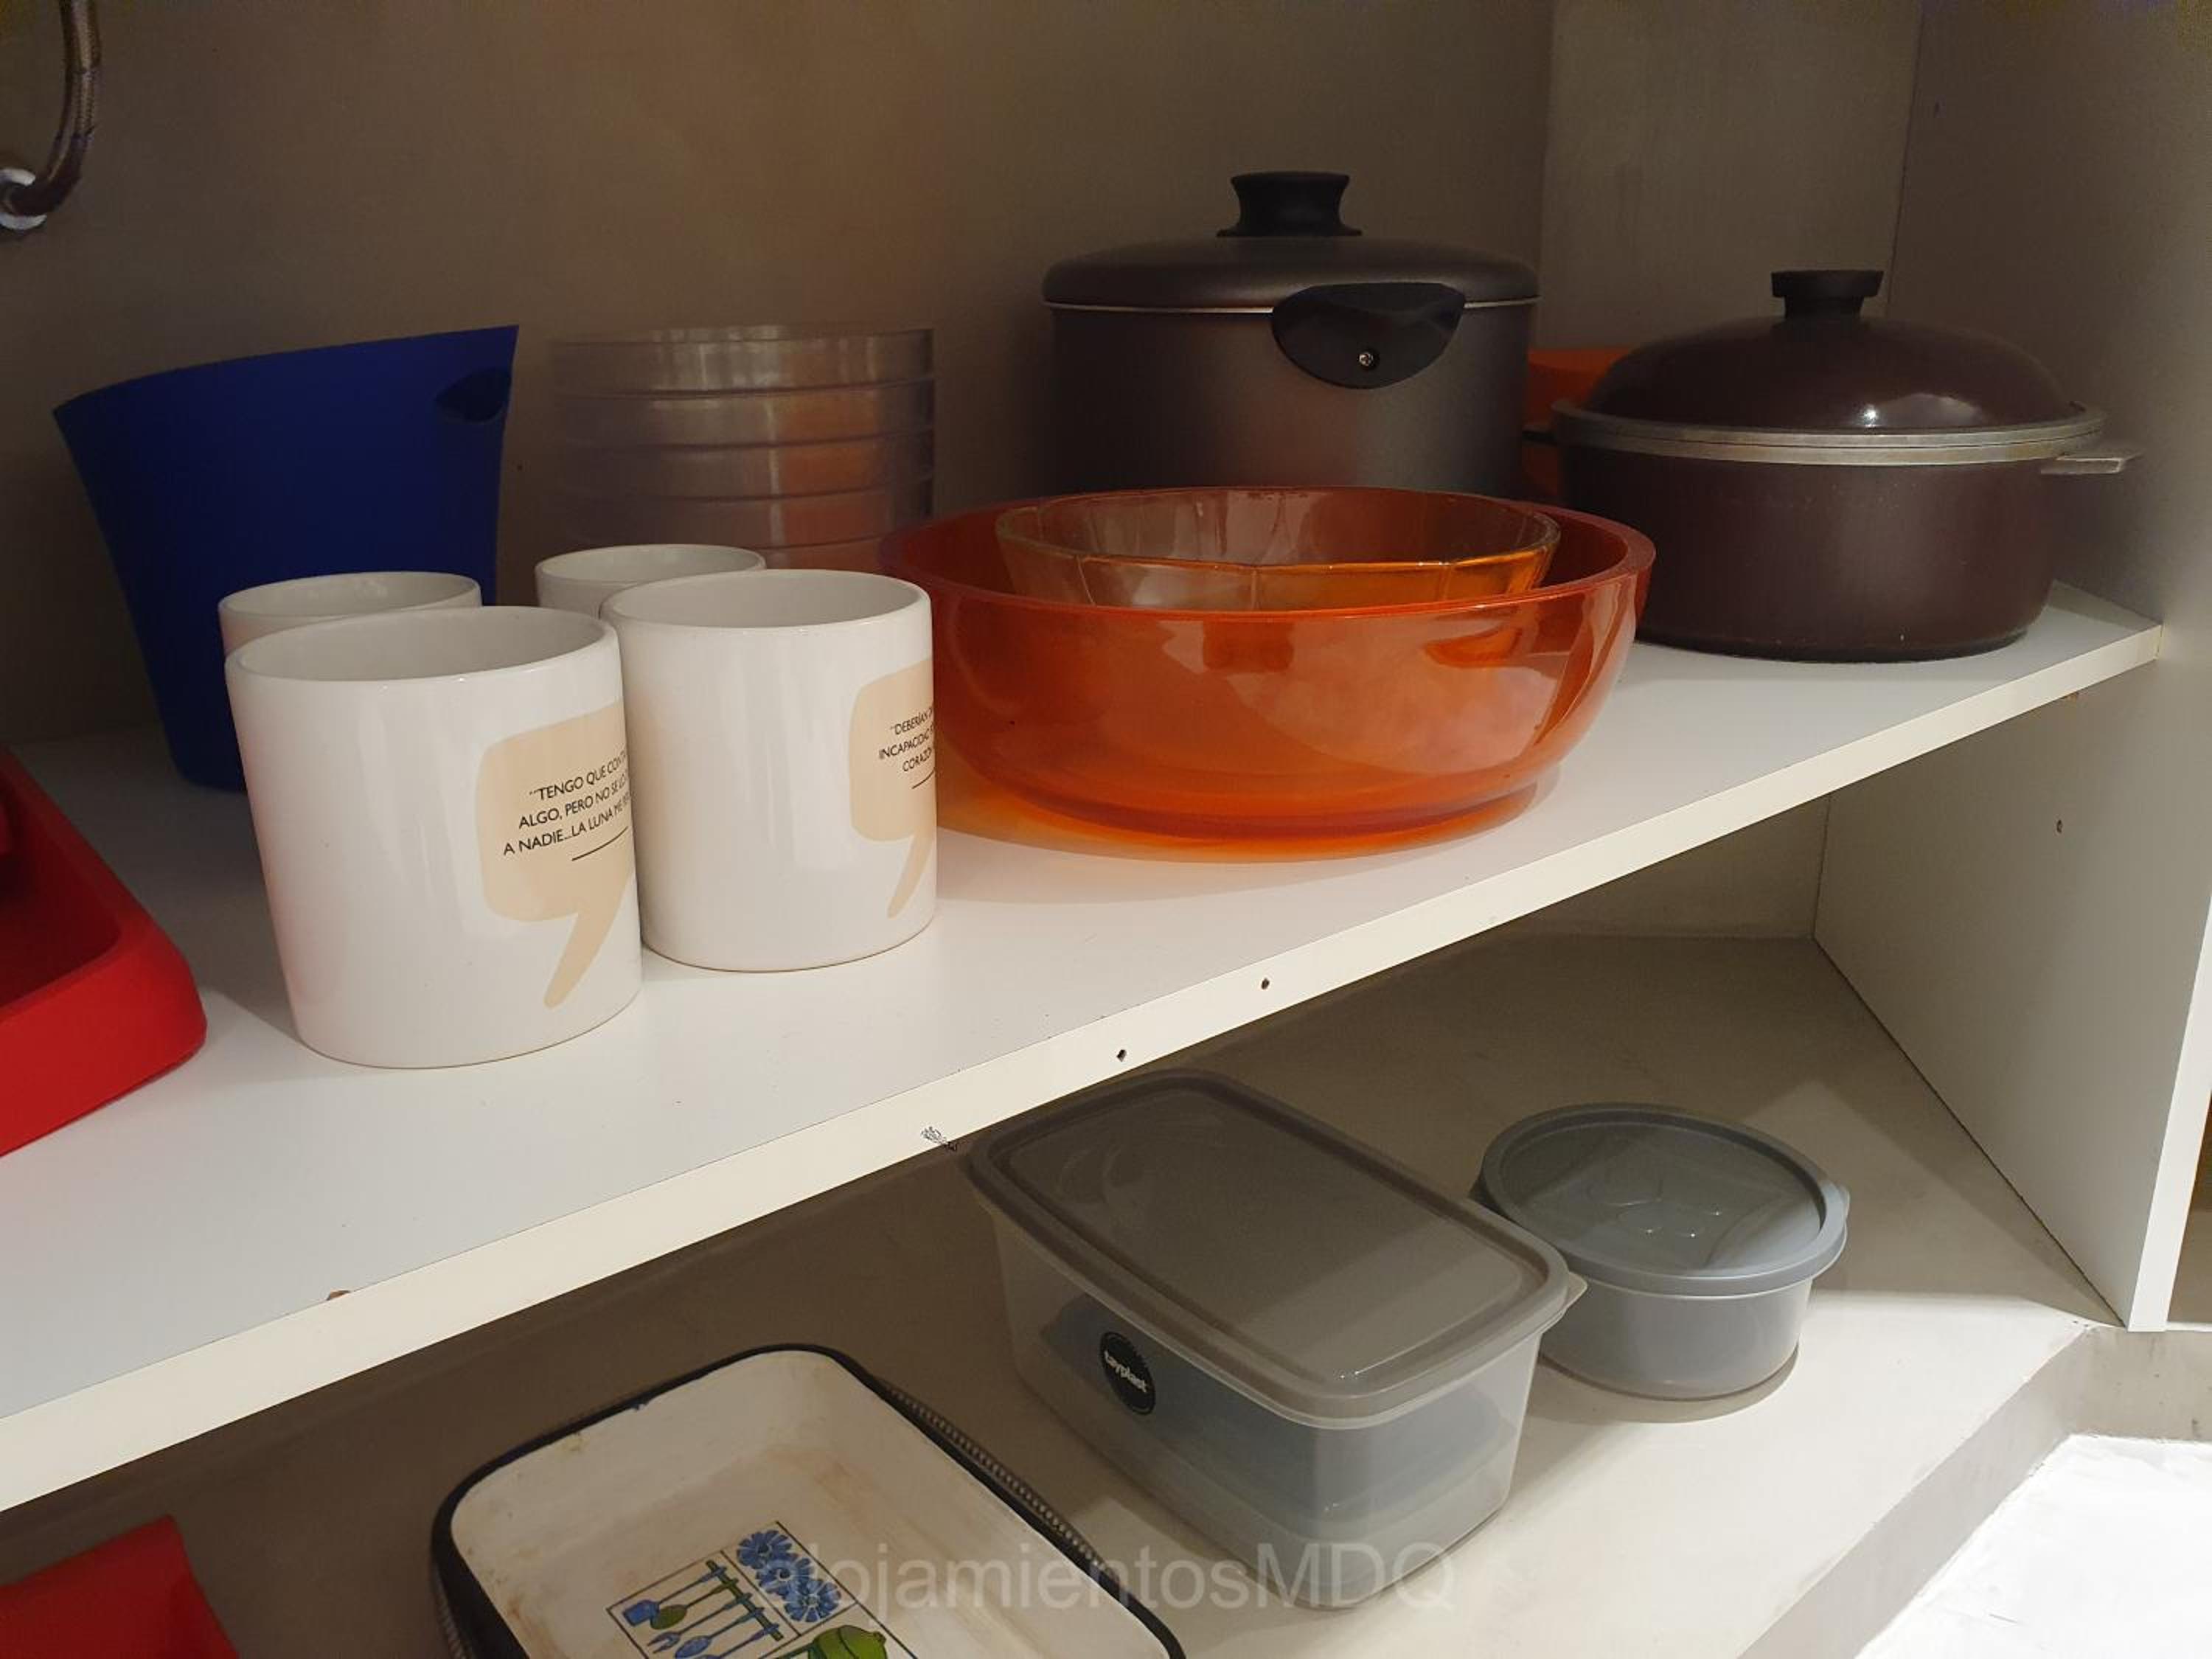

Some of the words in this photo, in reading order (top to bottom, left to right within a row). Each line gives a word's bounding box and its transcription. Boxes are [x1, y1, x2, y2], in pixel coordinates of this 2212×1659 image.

[586, 765, 605, 785] QUE
[519, 808, 563, 829] ALGO,
[565, 796, 594, 816] PERO
[595, 787, 610, 804] NO
[503, 842, 515, 856] A
[589, 807, 613, 830] LUNA
